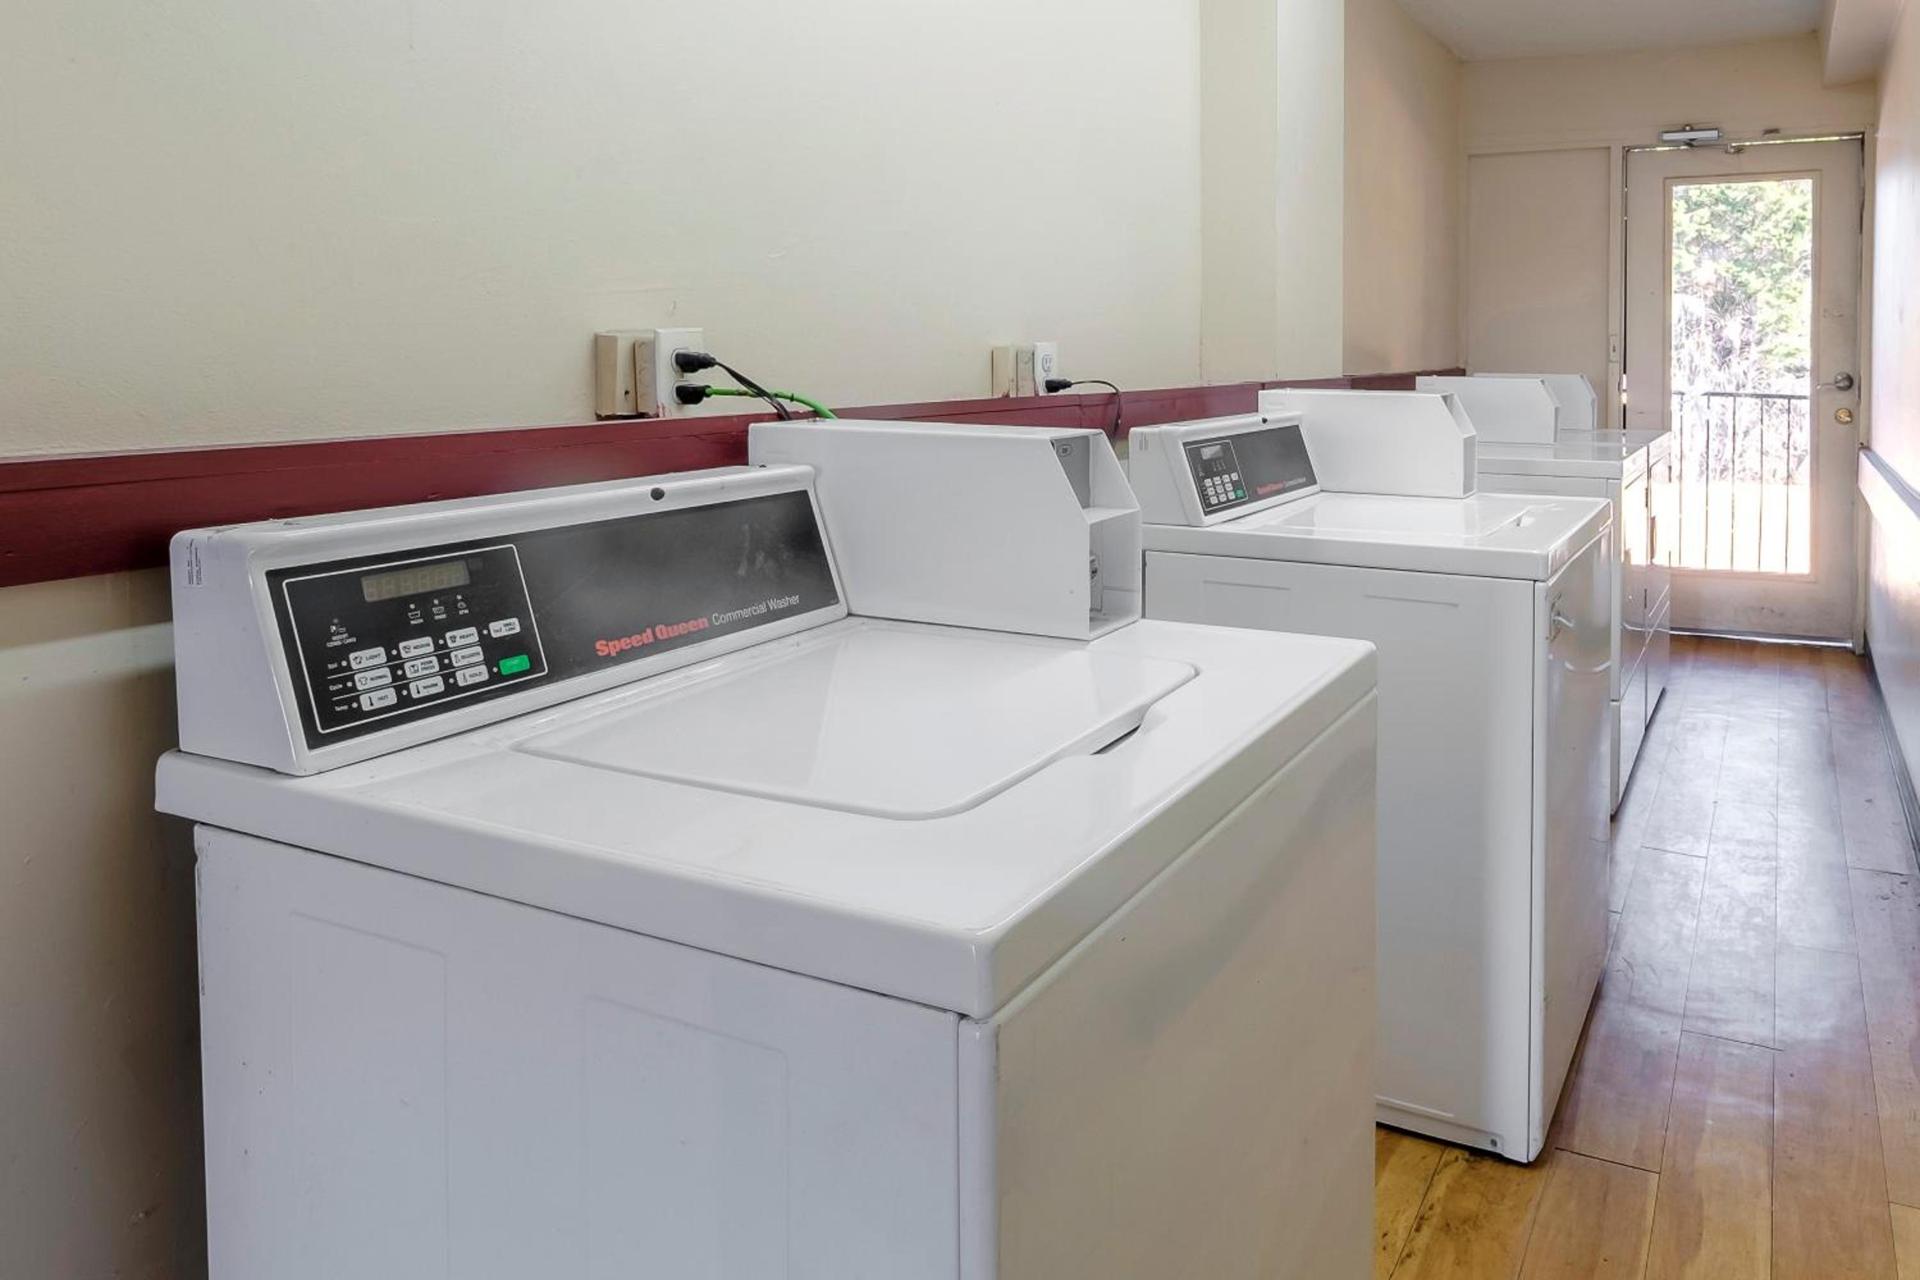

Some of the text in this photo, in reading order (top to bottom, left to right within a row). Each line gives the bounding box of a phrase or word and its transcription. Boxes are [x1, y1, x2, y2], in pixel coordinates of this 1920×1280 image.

[595, 593, 800, 656] Speed Queen Commercial Washer
